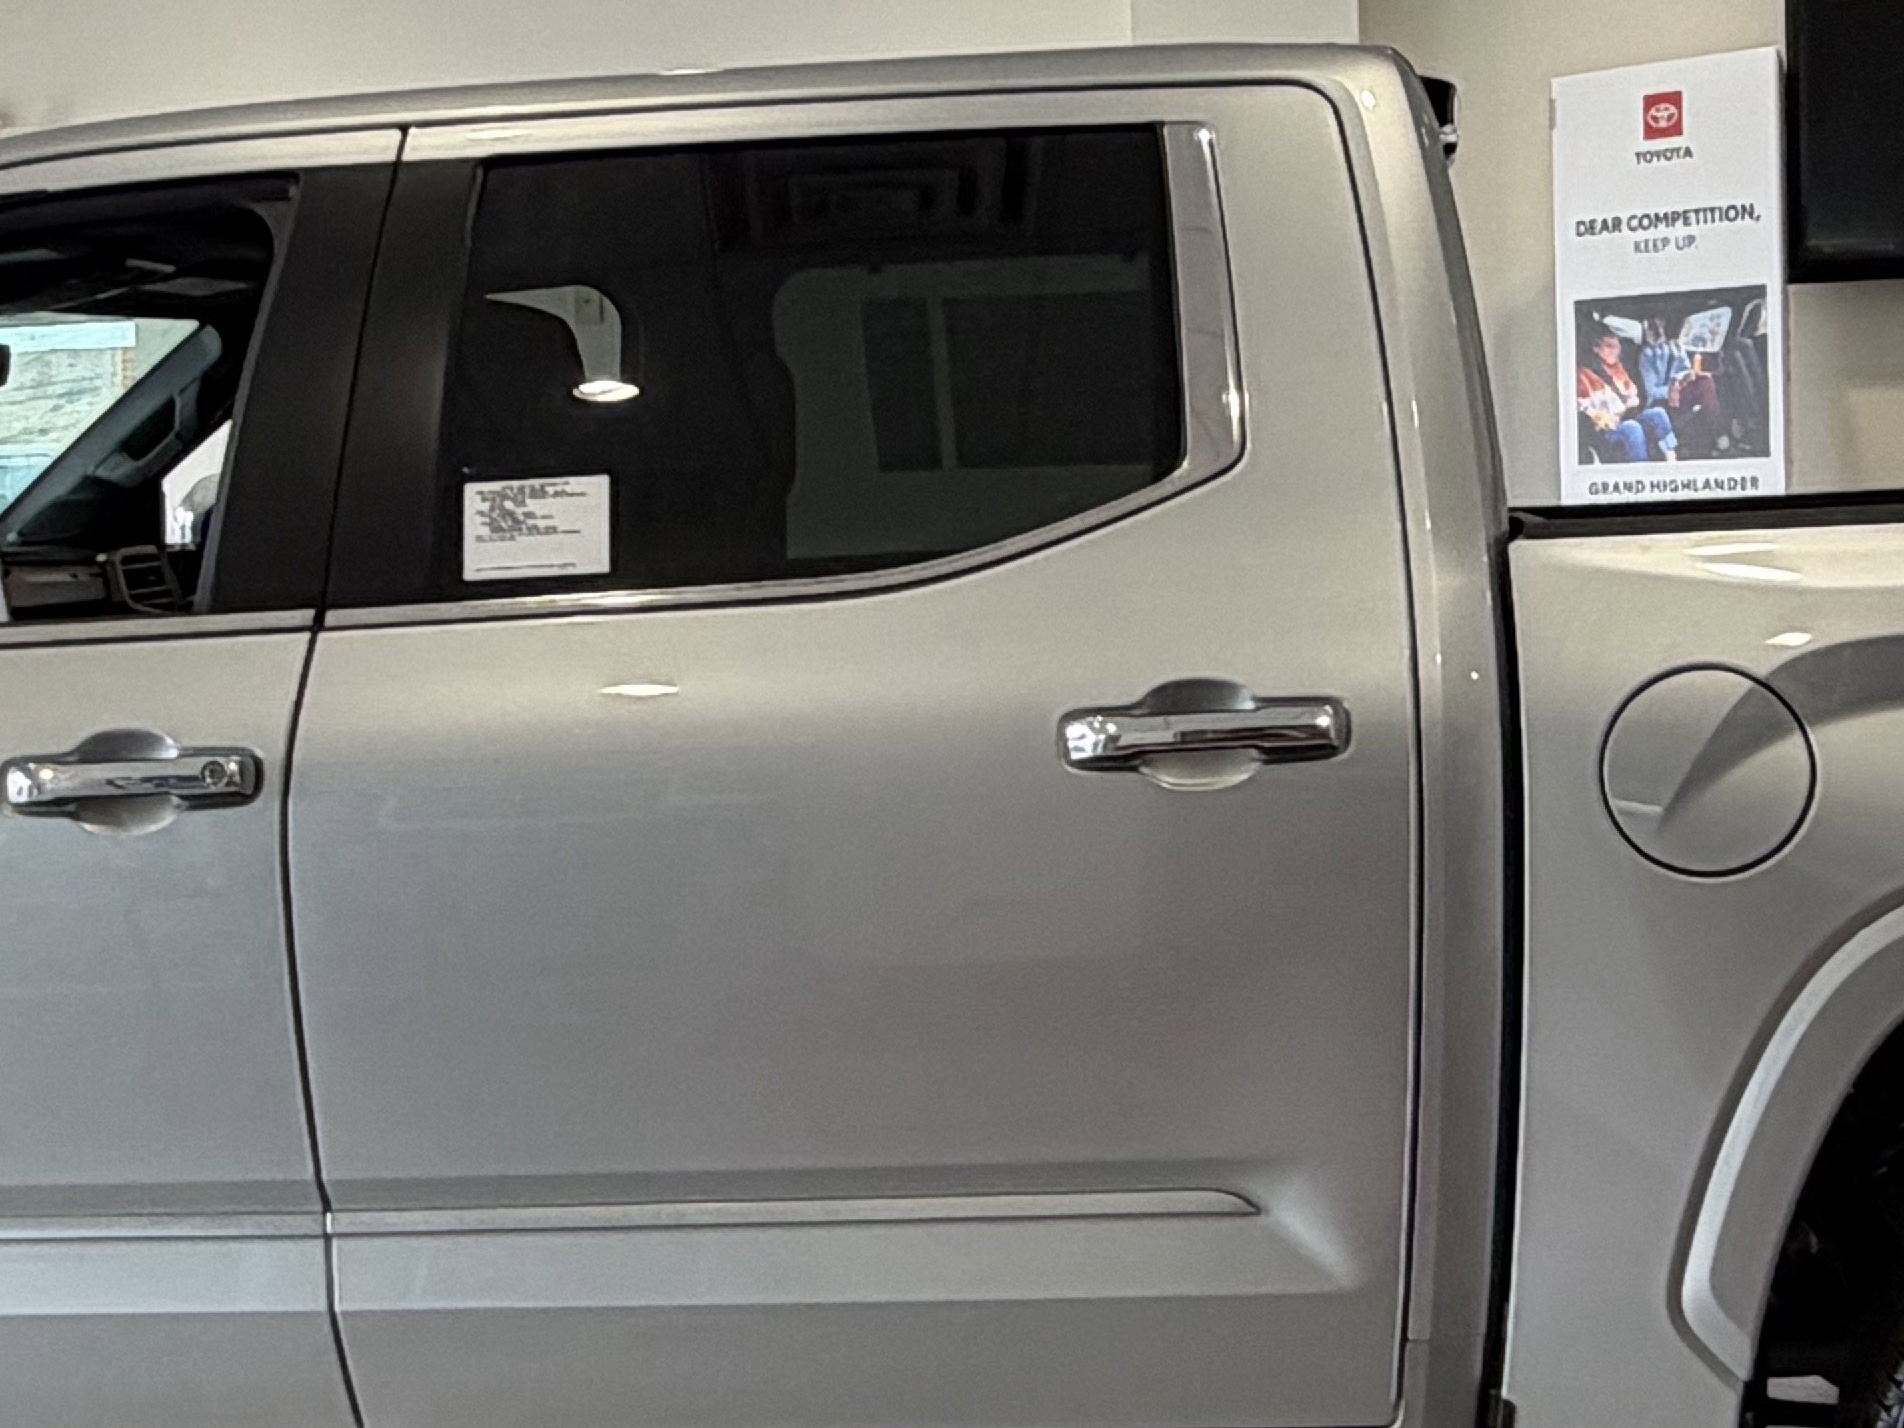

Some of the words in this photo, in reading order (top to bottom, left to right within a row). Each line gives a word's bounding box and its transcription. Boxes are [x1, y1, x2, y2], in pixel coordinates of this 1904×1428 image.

[1634, 146, 1694, 165] TOYOTA
[1575, 217, 1623, 238] DEAR
[1626, 202, 1762, 233] COMPETITION,
[1633, 236, 1671, 255] KEEP
[1588, 479, 1646, 496] GRAND
[1649, 475, 1761, 494] HIGHLANDER
